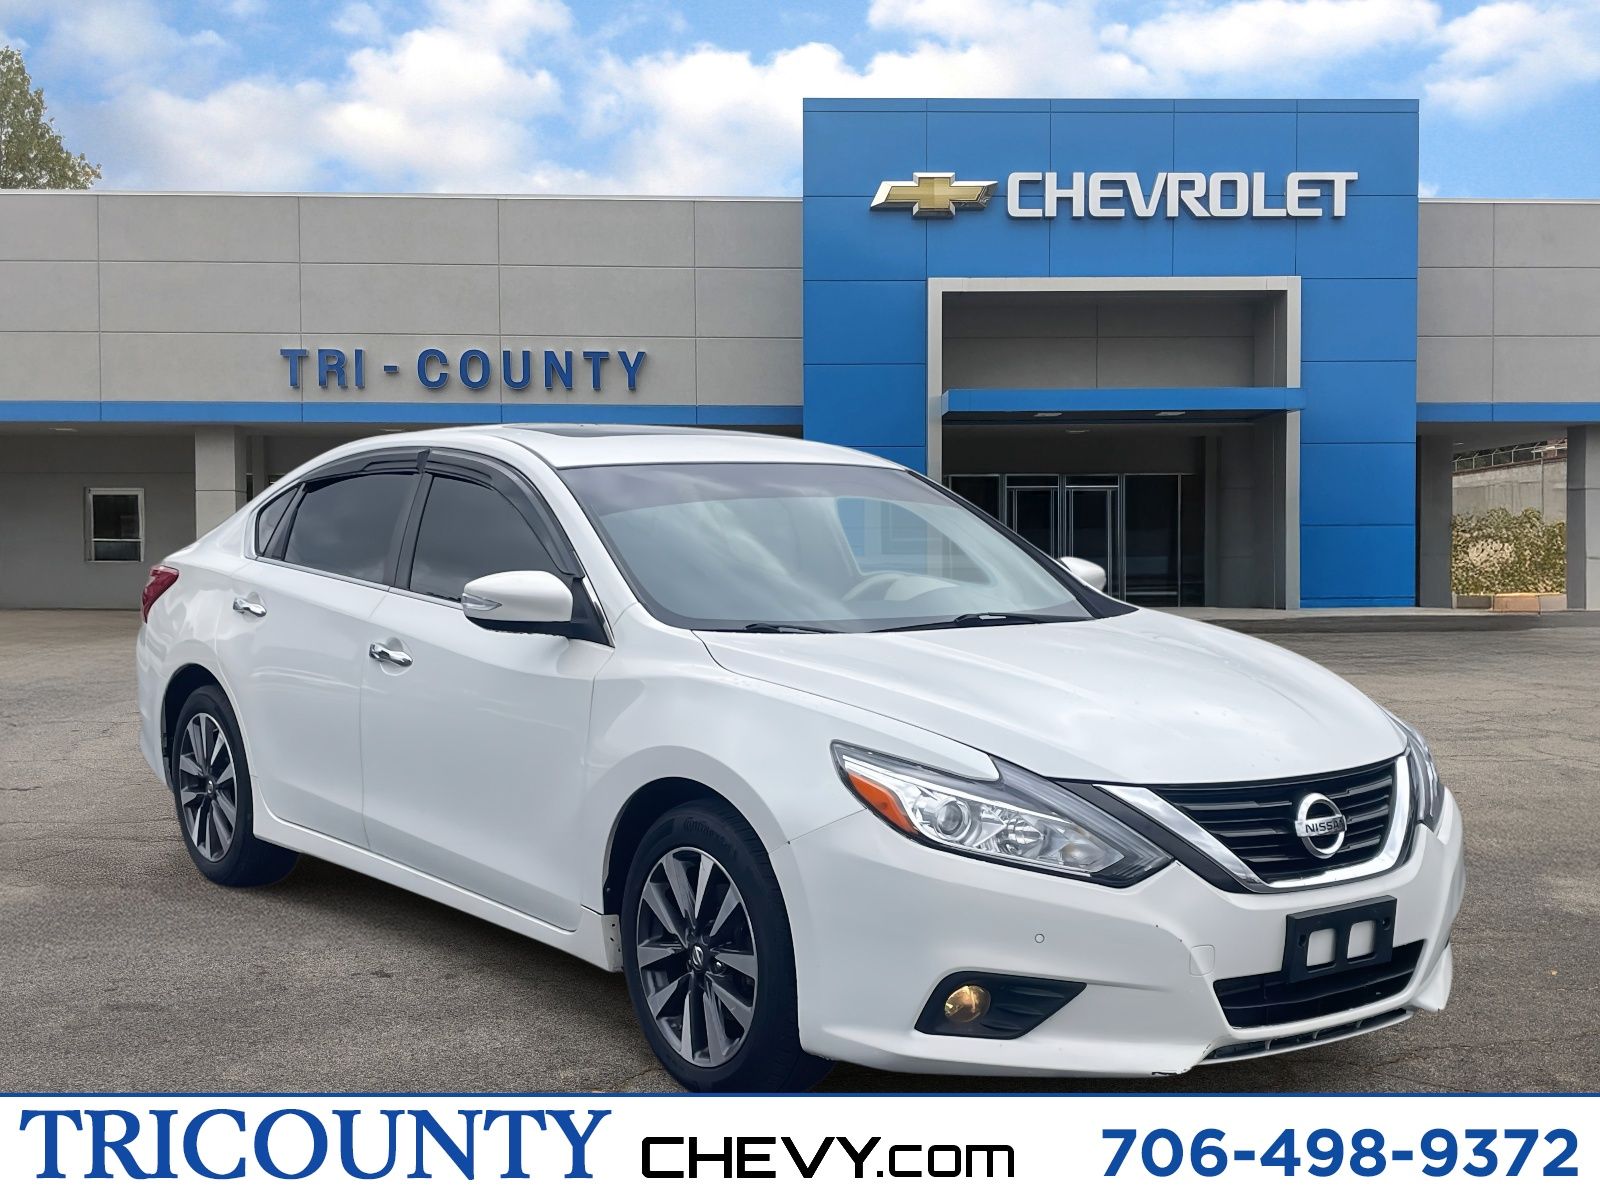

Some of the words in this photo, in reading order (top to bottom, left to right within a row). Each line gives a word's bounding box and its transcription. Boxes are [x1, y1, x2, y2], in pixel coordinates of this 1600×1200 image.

[1006, 171, 1359, 219] CHEVROLET
[280, 348, 366, 390] TRI
[416, 348, 647, 391] COUNTY
